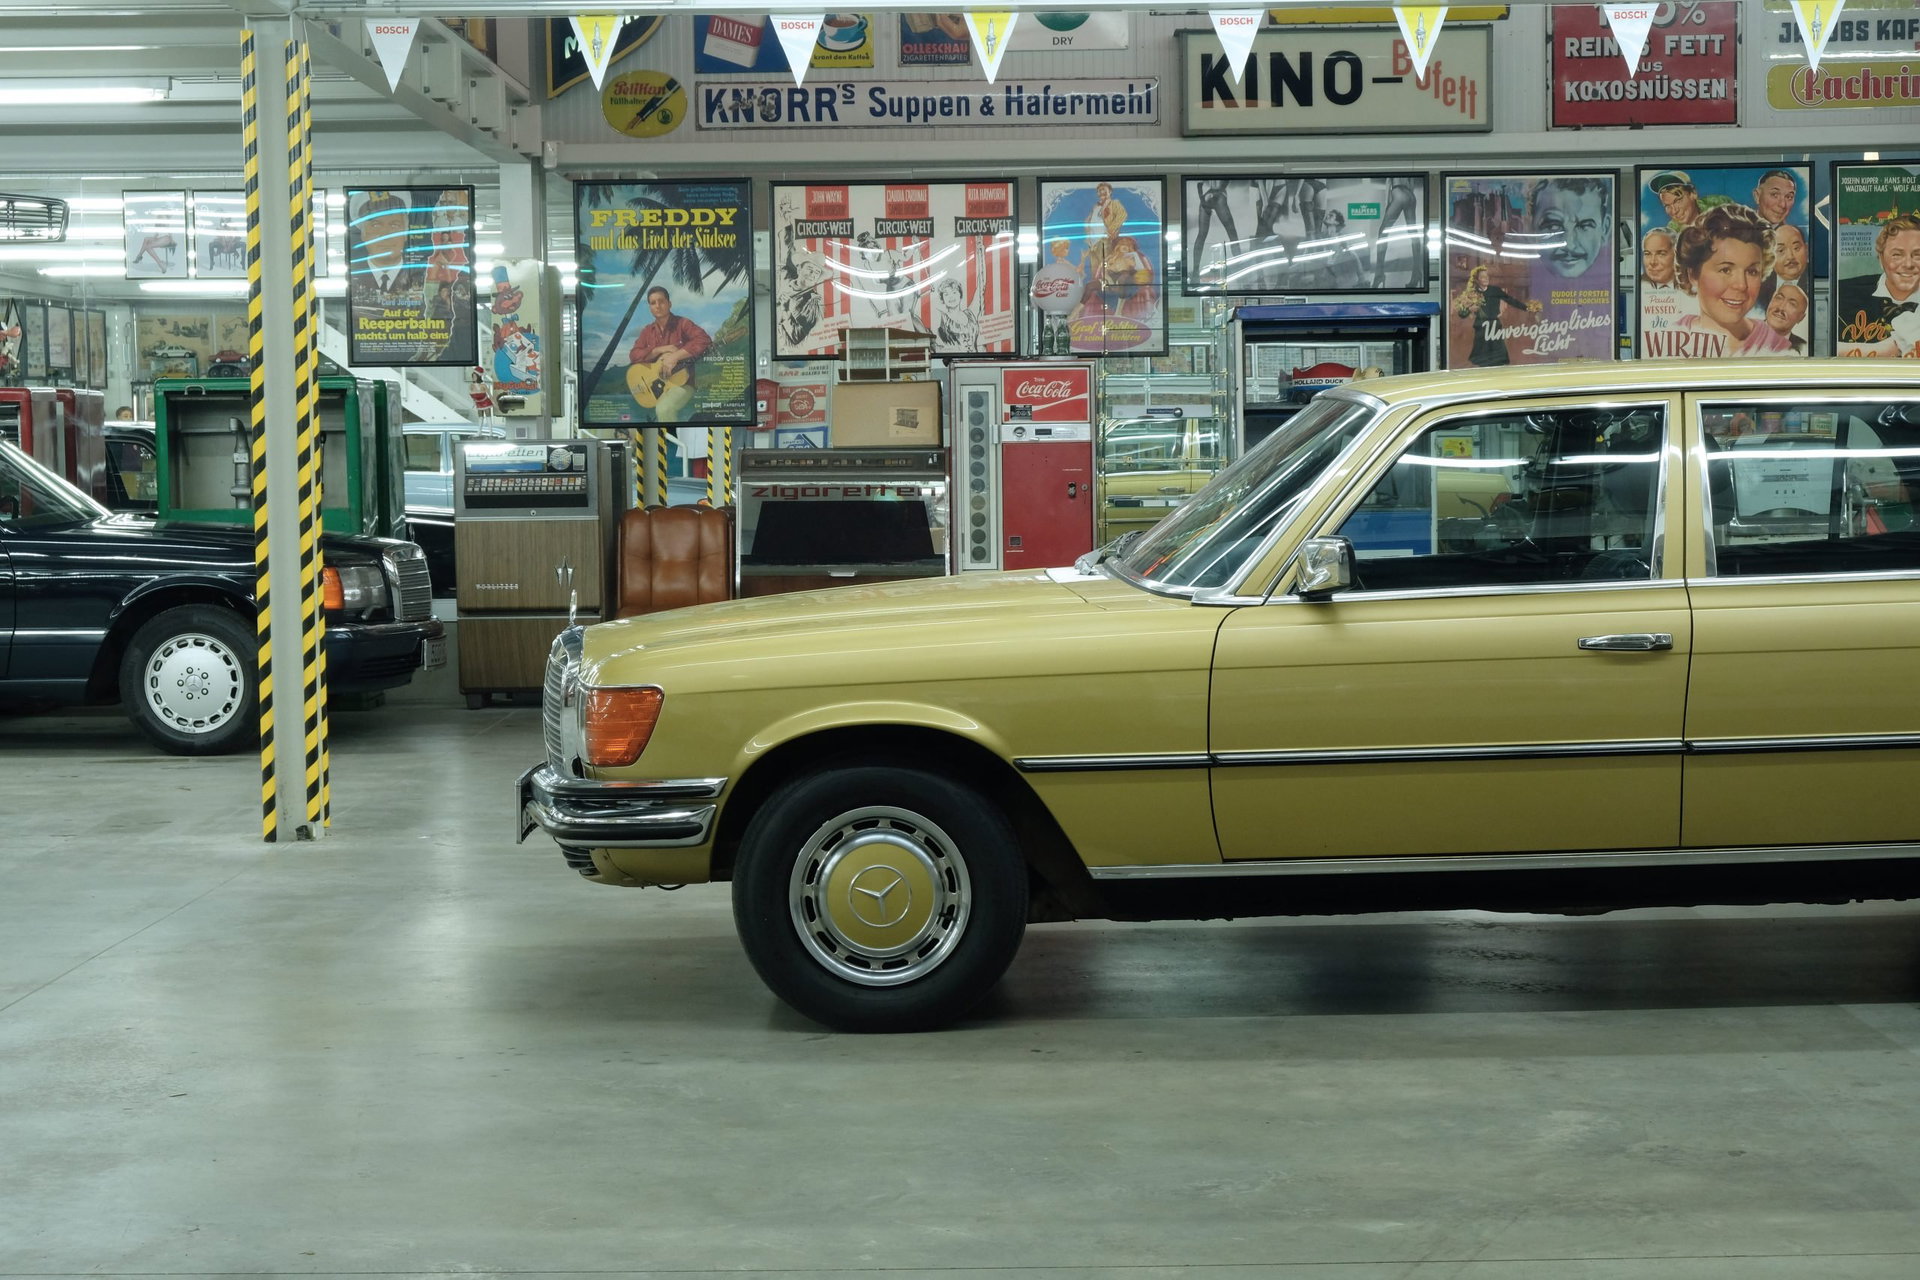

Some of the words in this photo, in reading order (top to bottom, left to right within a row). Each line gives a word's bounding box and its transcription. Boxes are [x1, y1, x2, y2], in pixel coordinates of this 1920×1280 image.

[1220, 17, 1254, 26] BOSCH
[1614, 11, 1648, 19] BOSCH
[375, 26, 410, 34] BOSCH
[713, 18, 753, 44] DAMES
[780, 22, 815, 30] BOSCH
[1779, 20, 1869, 43] JABS
[903, 43, 968, 54] OLLESCHAU
[1052, 37, 1074, 46] DRY
[1565, 37, 1650, 57] REINS
[1665, 34, 1725, 55] FETT
[903, 54, 968, 62] ZIGARETTENPAPIER
[1635, 62, 1663, 72] US
[1565, 75, 1727, 101] KOKOSNÜSSEN
[869, 87, 970, 122] Suppen
[979, 97, 995, 116] &
[1005, 84, 1151, 116] Hafermehl
[590, 208, 738, 227] FREDDY
[797, 221, 852, 236] CIRCUS-WELT
[877, 220, 932, 235] CIRCUS-WELT
[957, 218, 1012, 234] CIRCUS-WELT
[590, 229, 613, 250] und
[617, 229, 638, 249] das
[643, 227, 669, 249] Lied
[672, 229, 693, 249] der
[695, 226, 737, 249] Südsee
[383, 309, 401, 317] Auf
[403, 309, 420, 317] der
[1644, 306, 1677, 314] WESSELY
[359, 317, 445, 332] Reeperbahn
[1482, 309, 1611, 342] Unvergängliches
[354, 332, 387, 340] nachts
[407, 332, 428, 340] halb
[1522, 333, 1576, 356] Licht
[1644, 331, 1728, 358] WIRTIN
[1016, 380, 1073, 398] Coca-Cola
